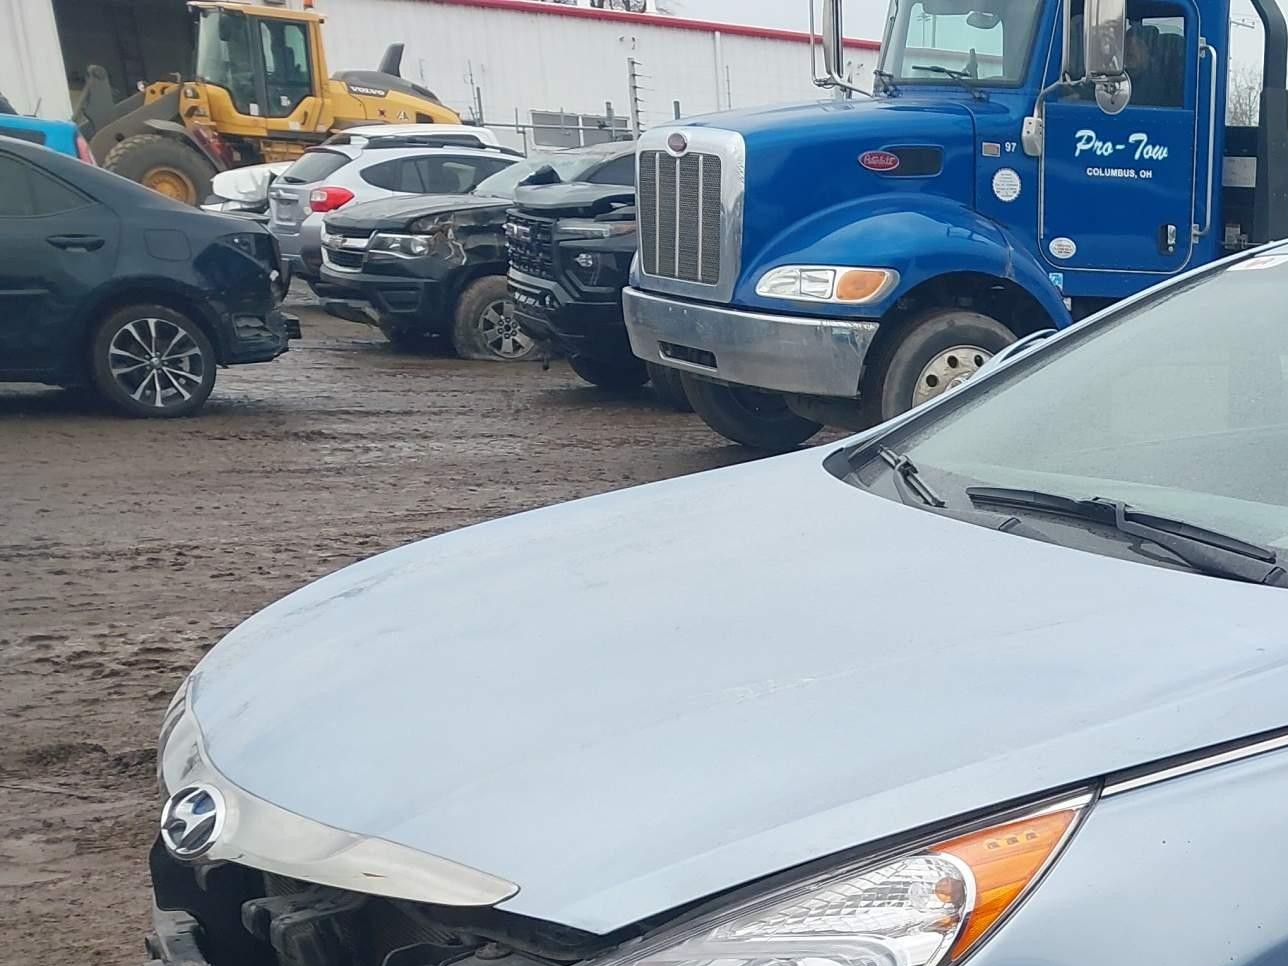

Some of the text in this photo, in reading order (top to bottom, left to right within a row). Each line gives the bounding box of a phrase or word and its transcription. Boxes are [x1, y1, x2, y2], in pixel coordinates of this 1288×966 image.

[350, 86, 385, 95] VOLVO
[1004, 141, 1017, 152] 97
[1074, 129, 1168, 161] Pro-Tow
[1086, 167, 1153, 179] COLUMBUS, OH
